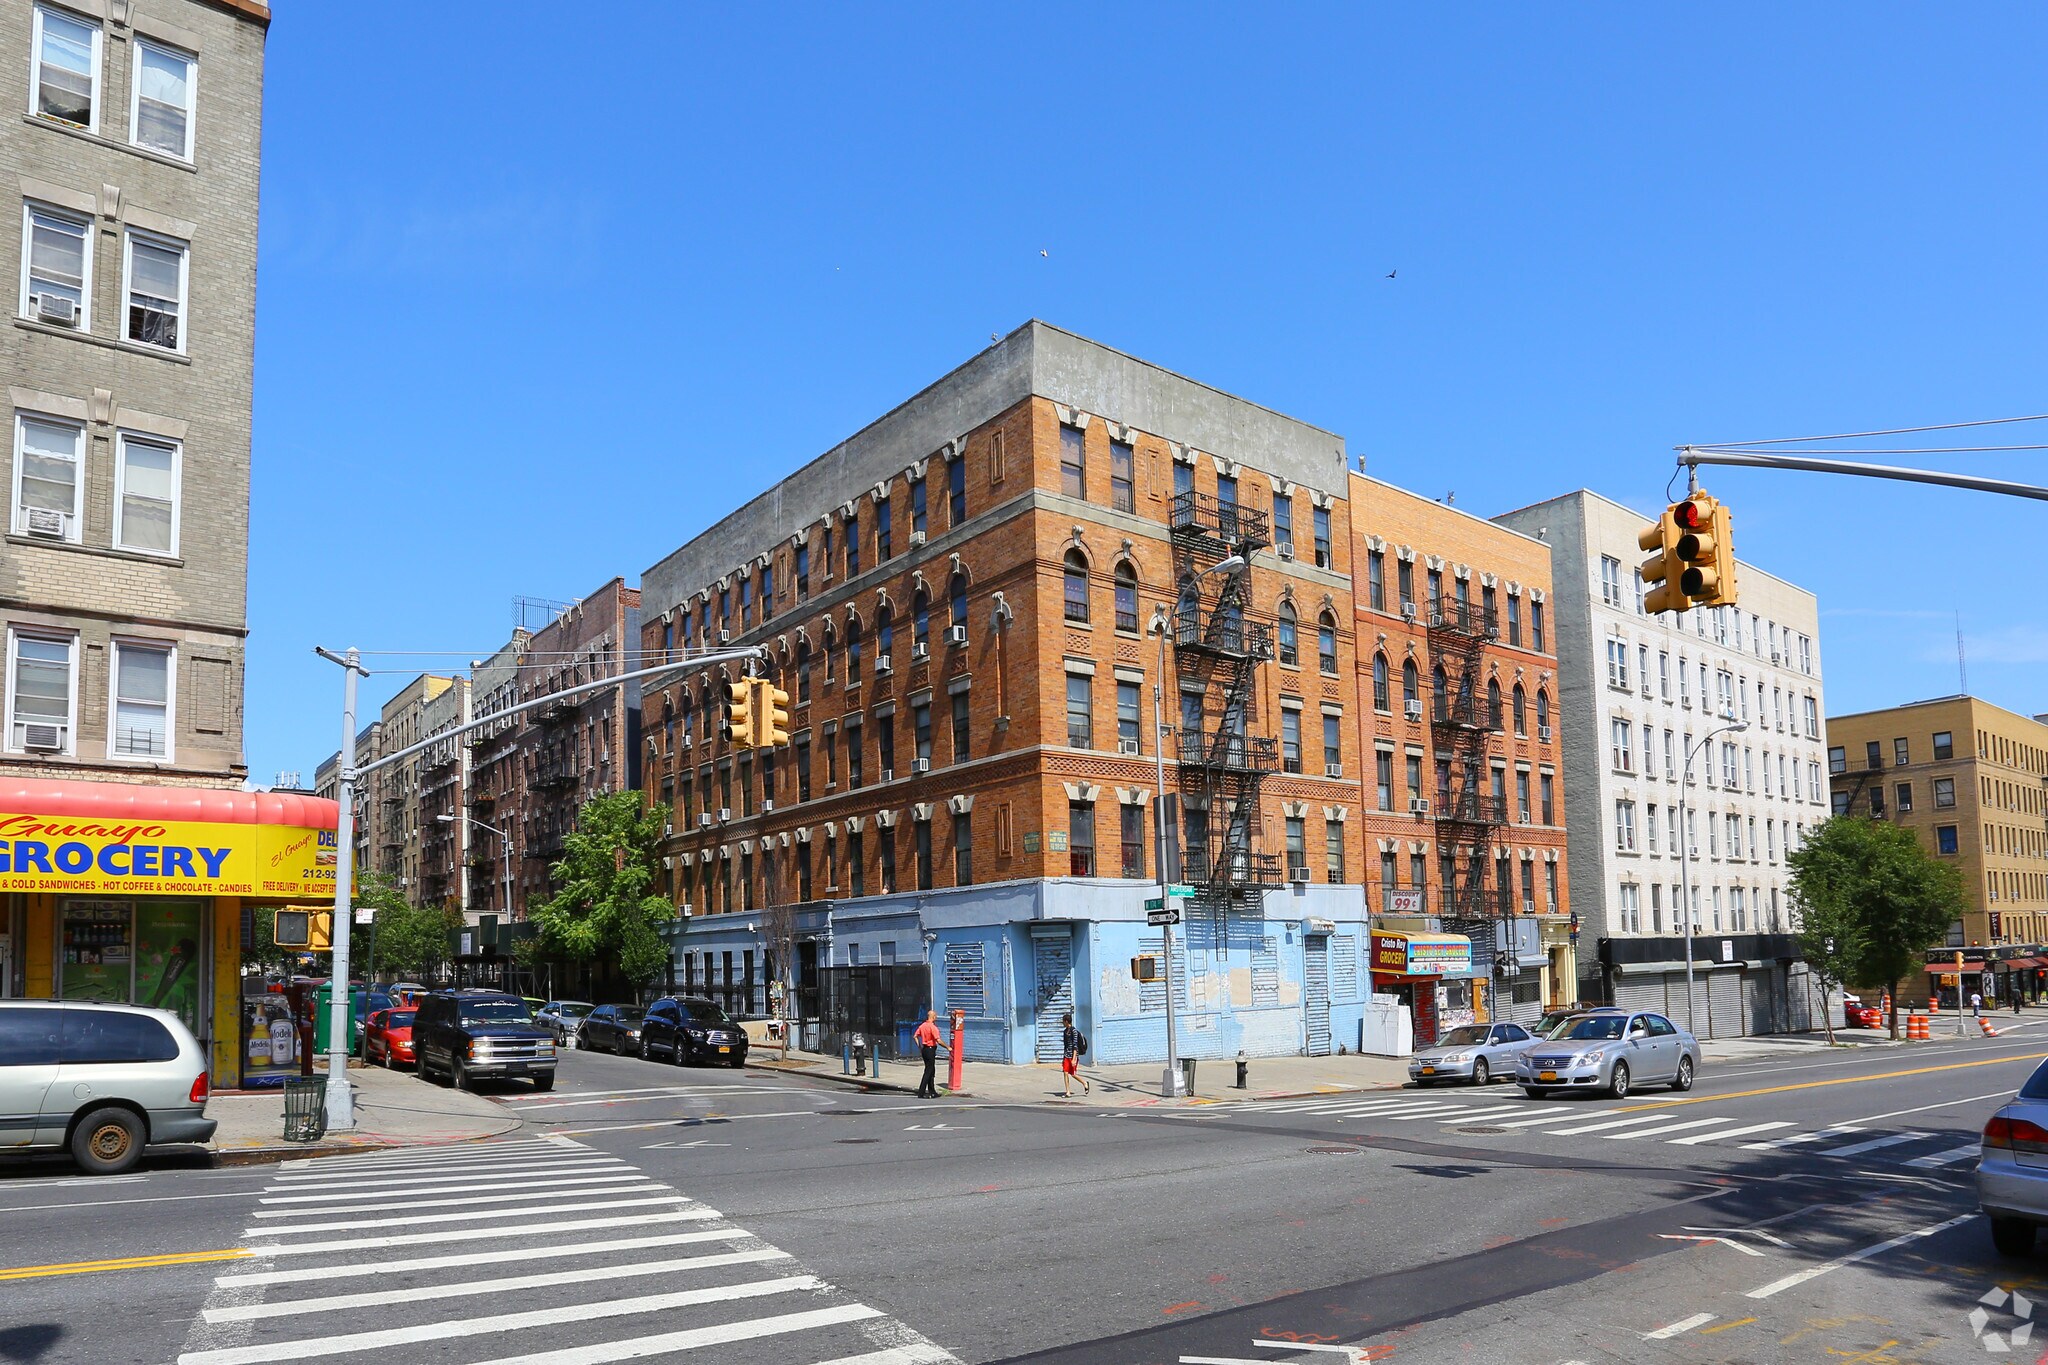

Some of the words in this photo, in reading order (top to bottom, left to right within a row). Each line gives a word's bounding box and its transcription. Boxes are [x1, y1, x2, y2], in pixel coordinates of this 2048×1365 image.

[0, 816, 166, 845] Guayo
[318, 831, 337, 847] DEL
[271, 853, 283, 867] El
[285, 834, 312, 857] Guayo
[0, 840, 232, 878] ROCERY
[2, 880, 8, 888] &
[12, 880, 35, 889] COLD
[39, 880, 95, 890] SANDWICHES
[103, 881, 120, 890] HOT
[123, 882, 154, 891] COFFEE
[157, 883, 161, 891] &
[165, 883, 212, 892] CHOCOLATE
[219, 884, 252, 892] CANDIES
[263, 881, 275, 891] FREE
[277, 882, 299, 892] DELIVERY
[304, 884, 311, 893] WE
[312, 884, 328, 893] ACCEPT
[1381, 938, 1396, 948] Cristo
[1396, 938, 1406, 951] Rey
[1380, 951, 1406, 964] GROCERY
